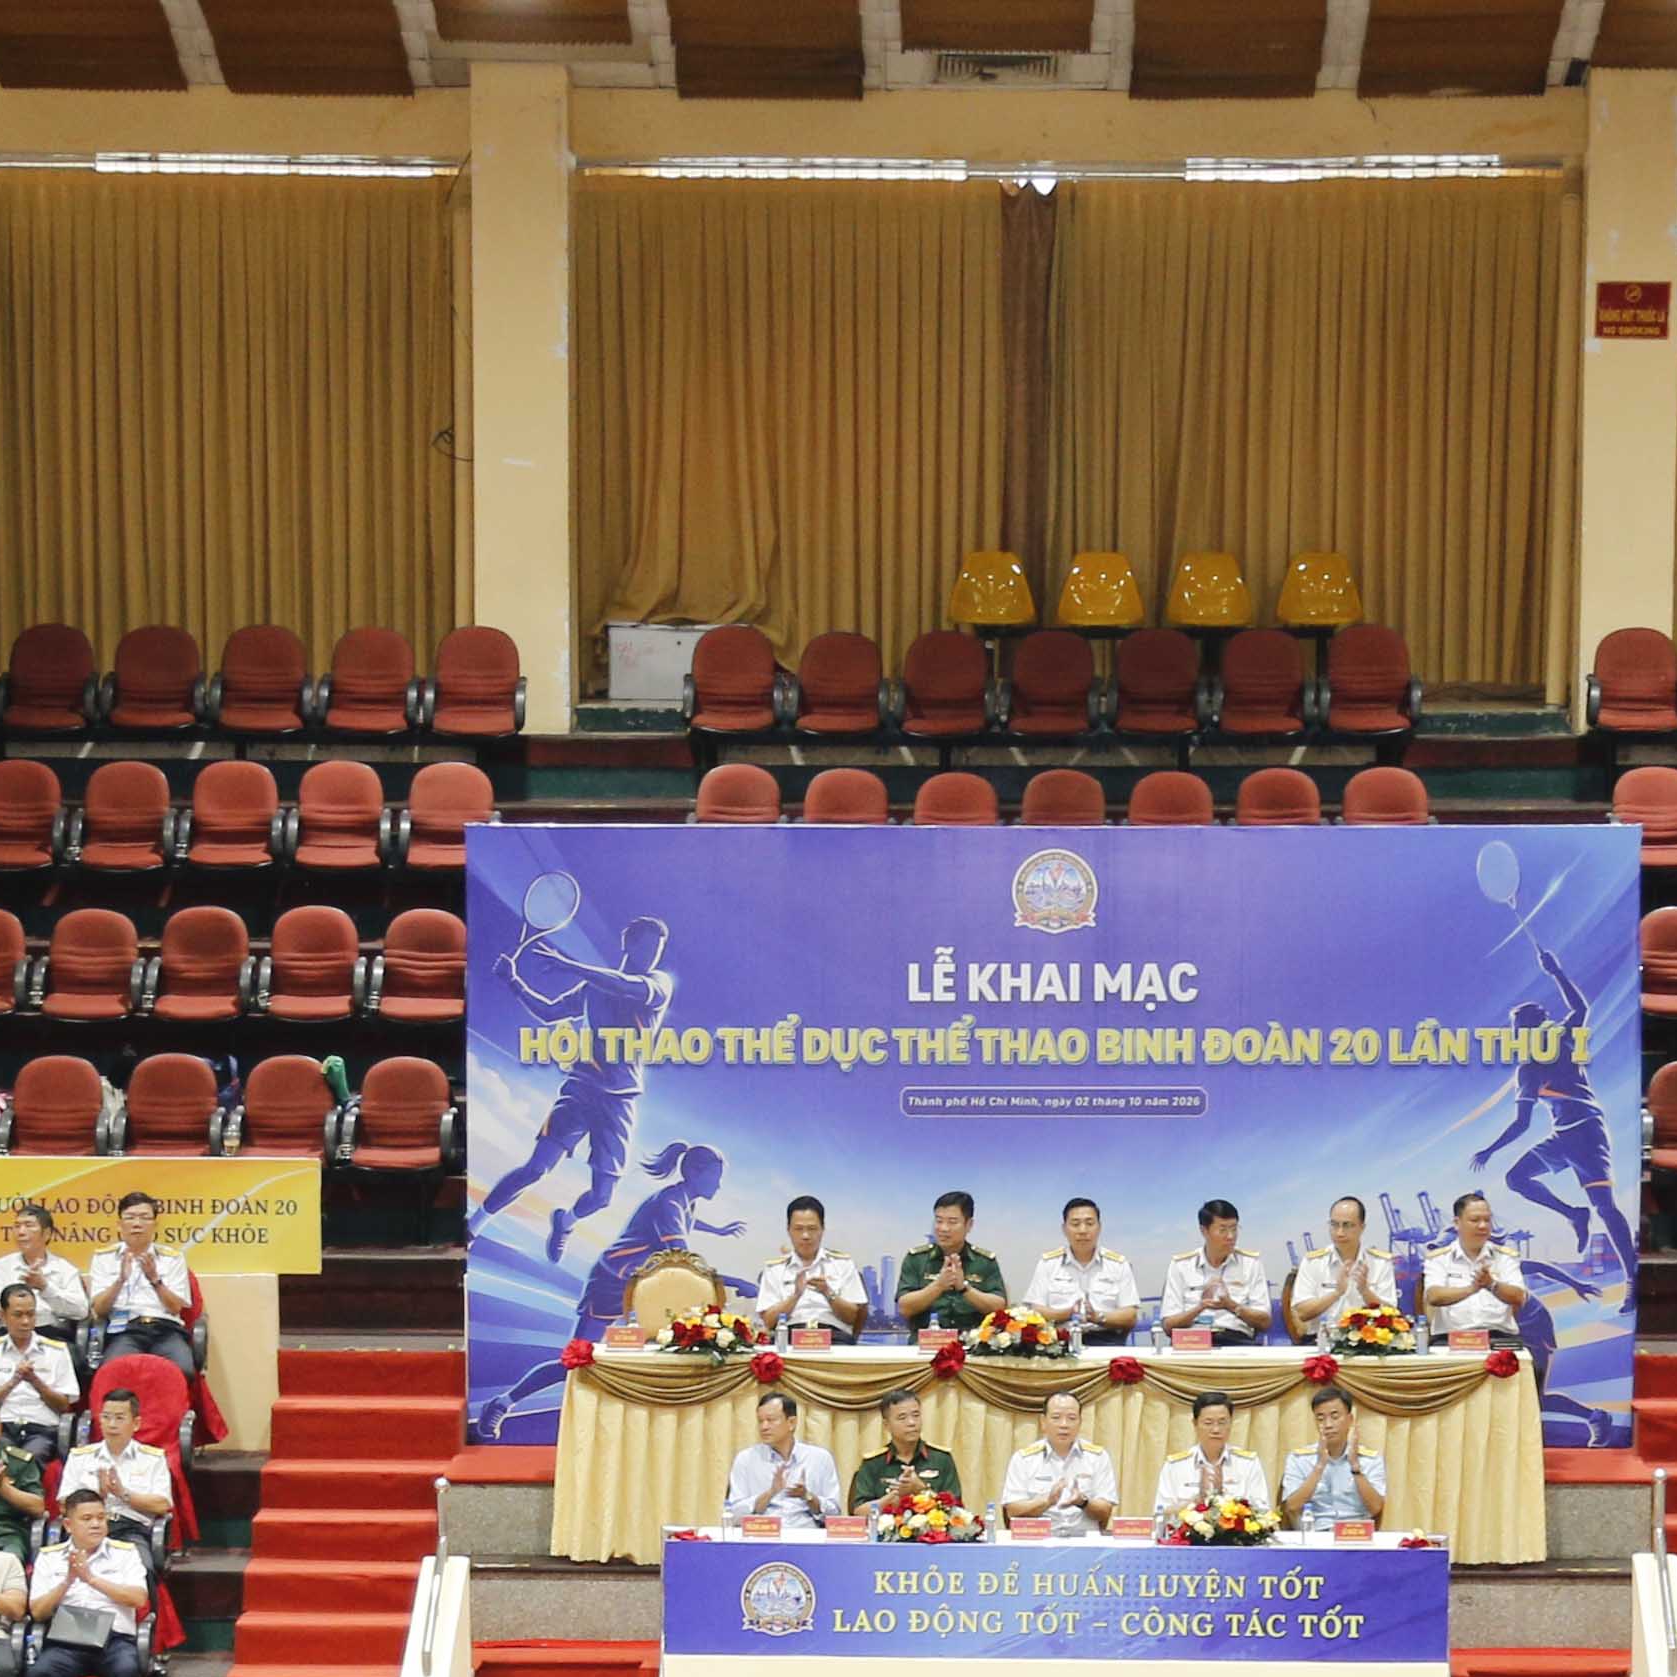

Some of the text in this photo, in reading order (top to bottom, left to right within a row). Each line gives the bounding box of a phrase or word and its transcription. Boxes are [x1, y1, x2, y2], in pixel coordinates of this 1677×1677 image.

[907, 946, 1199, 1012] LỄ KHAI MẠC
[519, 1013, 1593, 1072] HỘI THAO THỂ DỤC THỂ THAO BINH ĐOÀN 20 LẦN THỨ I
[907, 1095, 943, 1107] Thành
[945, 1095, 968, 1109] phố
[989, 1095, 1009, 1107] Chí
[1010, 1096, 1042, 1108] Minh,
[1044, 1096, 1072, 1109] ngày
[1074, 1096, 1090, 1107] 02
[1092, 1095, 1126, 1109] tháng
[1128, 1096, 1142, 1107] 10
[1144, 1096, 1170, 1108] năm
[1172, 1096, 1201, 1108] 2026
[210, 1194, 268, 1216] ĐOÀN
[275, 1199, 298, 1216] 20
[164, 1223, 204, 1243] SỨC
[211, 1224, 269, 1244] KHỎE
[874, 1560, 1325, 1604] KHỎE ĐỂ HUẤN LUYỆN TỐT
[832, 1601, 1365, 1640] LAO ĐỘNG TỐT CÔNG TÁC TỐT
